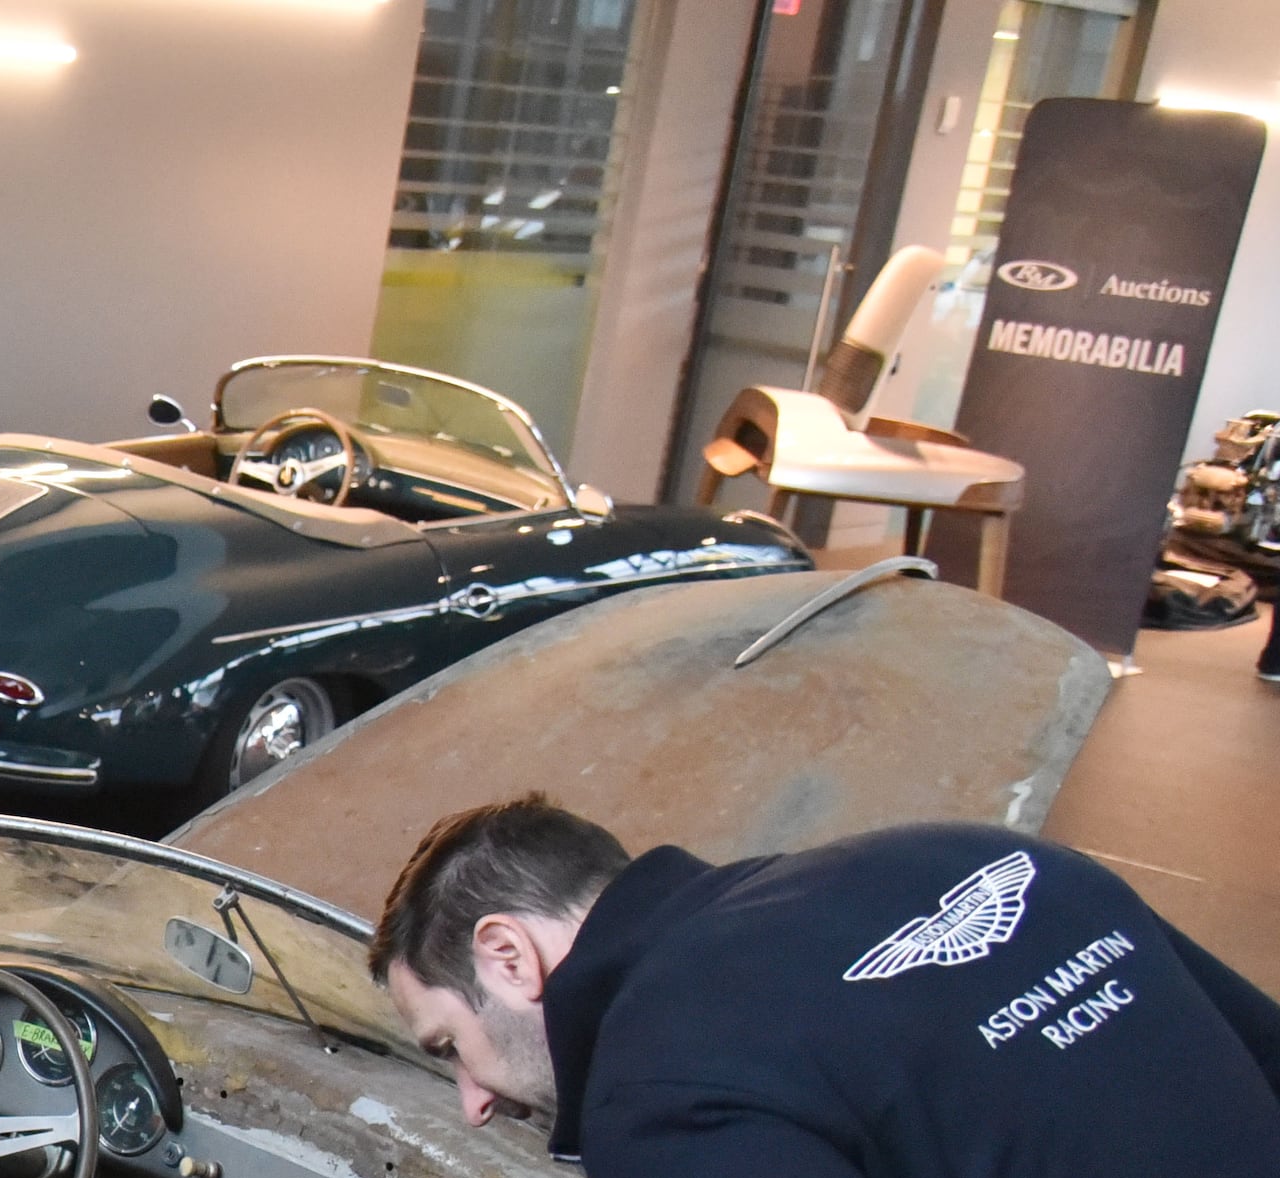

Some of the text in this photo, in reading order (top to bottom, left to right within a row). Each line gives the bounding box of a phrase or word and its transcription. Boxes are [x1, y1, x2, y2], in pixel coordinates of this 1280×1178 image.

[1100, 273, 1212, 307] Auctions
[987, 319, 1184, 377] MEMORABILIA
[913, 886, 993, 947] ASTON MARTIN
[977, 930, 1135, 1049] ASTON MARTIN
[1040, 979, 1135, 1050] RACING
